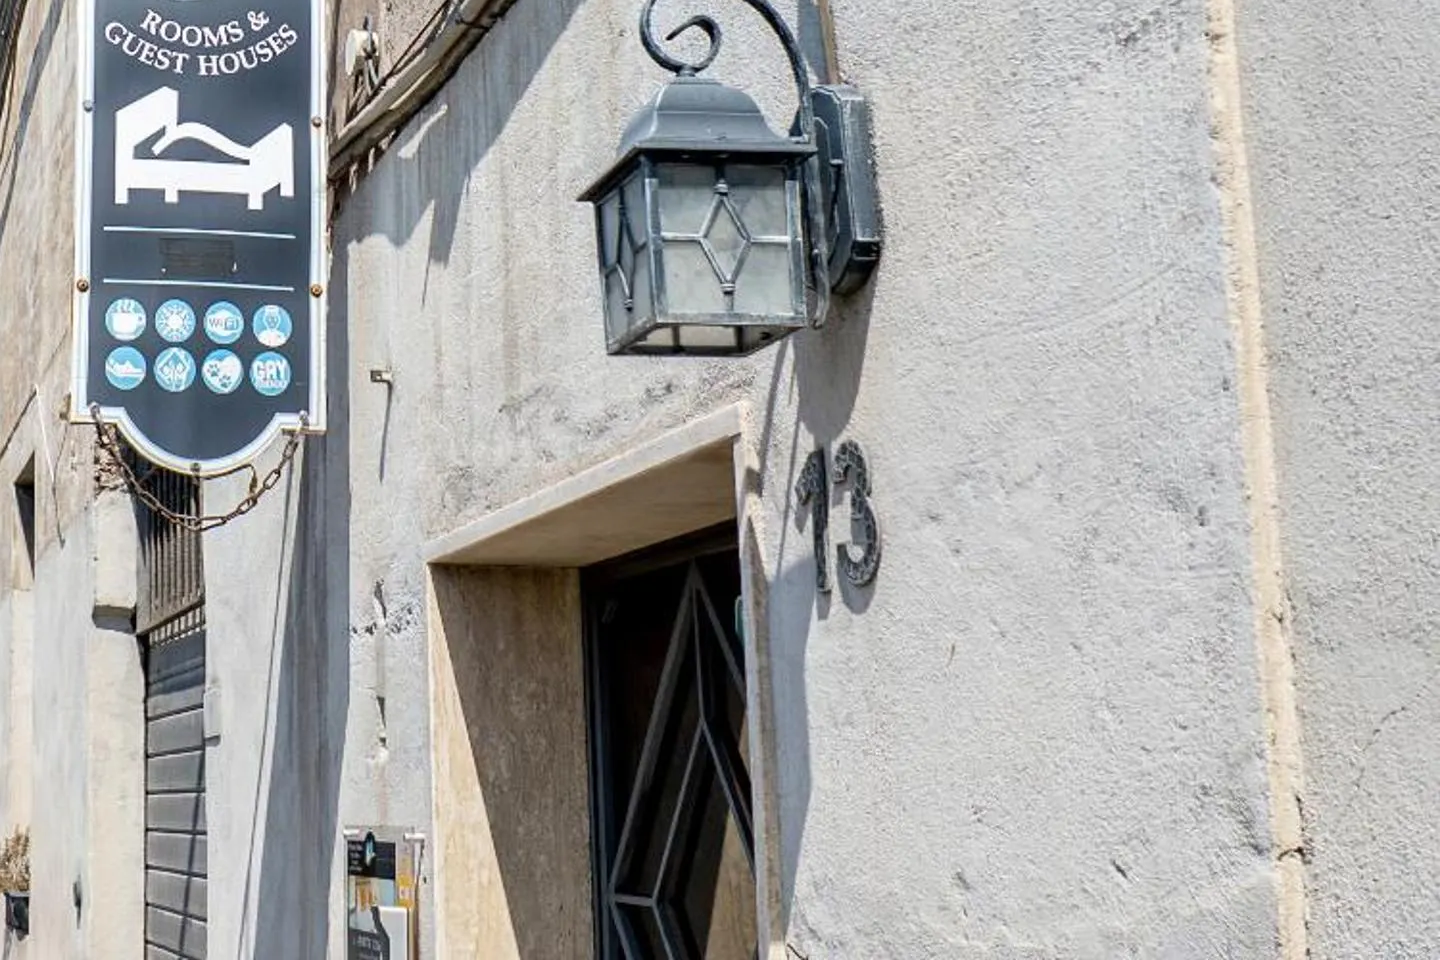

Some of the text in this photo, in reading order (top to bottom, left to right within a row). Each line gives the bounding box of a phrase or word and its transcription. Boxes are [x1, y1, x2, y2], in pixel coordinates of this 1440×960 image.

[104, 21, 298, 76] GUEST HOUSES
[140, 8, 270, 47] ROOMS &
[794, 440, 879, 591] 13
